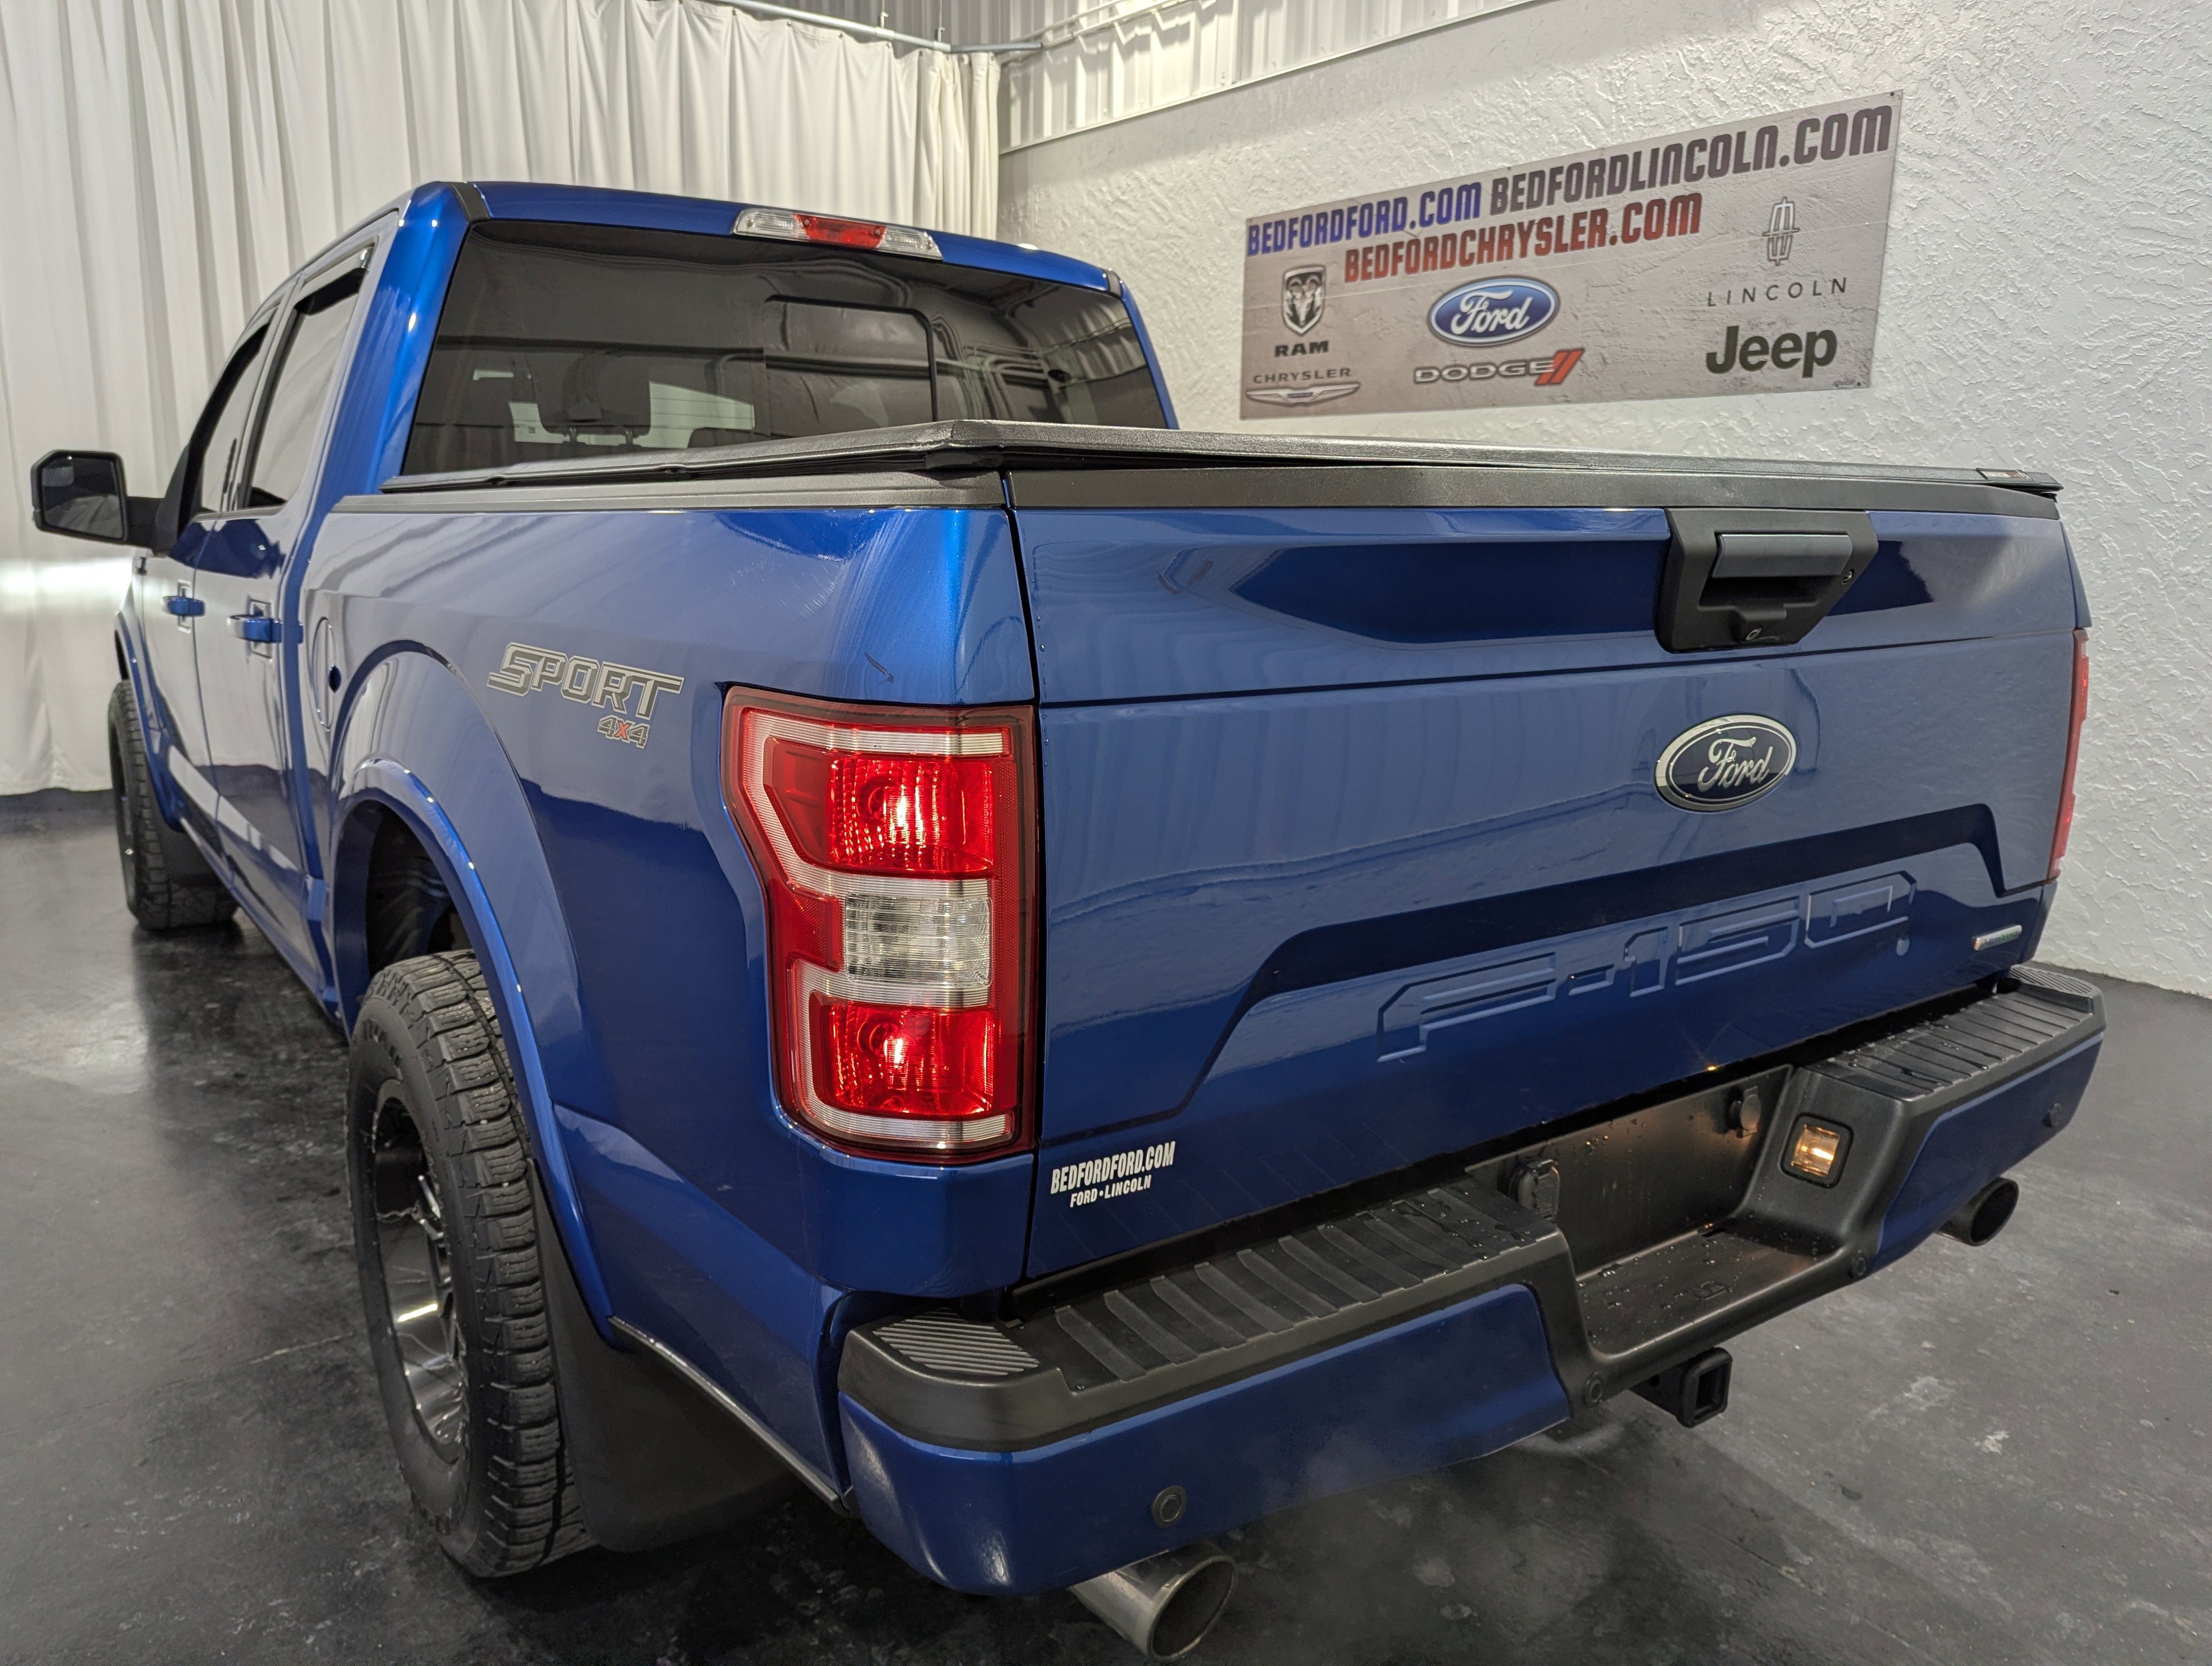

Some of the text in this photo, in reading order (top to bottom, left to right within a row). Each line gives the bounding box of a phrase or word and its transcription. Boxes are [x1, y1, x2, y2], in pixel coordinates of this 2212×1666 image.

[1248, 105, 1893, 258] BEDFORDFORD.COM BEDFORDLINCOLN.COM
[1344, 192, 1702, 284] BEDFORDCHRYSLER.COM
[1450, 290, 1533, 335] Ford
[1707, 277, 1847, 307] LINCOLN
[1252, 367, 1352, 385] CHRYSLER
[1274, 340, 1330, 358] RAM
[1414, 356, 1555, 384] DODGE
[1706, 325, 1838, 379] Jeep
[486, 642, 685, 720] SPORT
[1697, 736, 1773, 792] Ford
[1377, 870, 1917, 1063] F-150
[1050, 1140, 1176, 1195] BEDFORDFORD.COM
